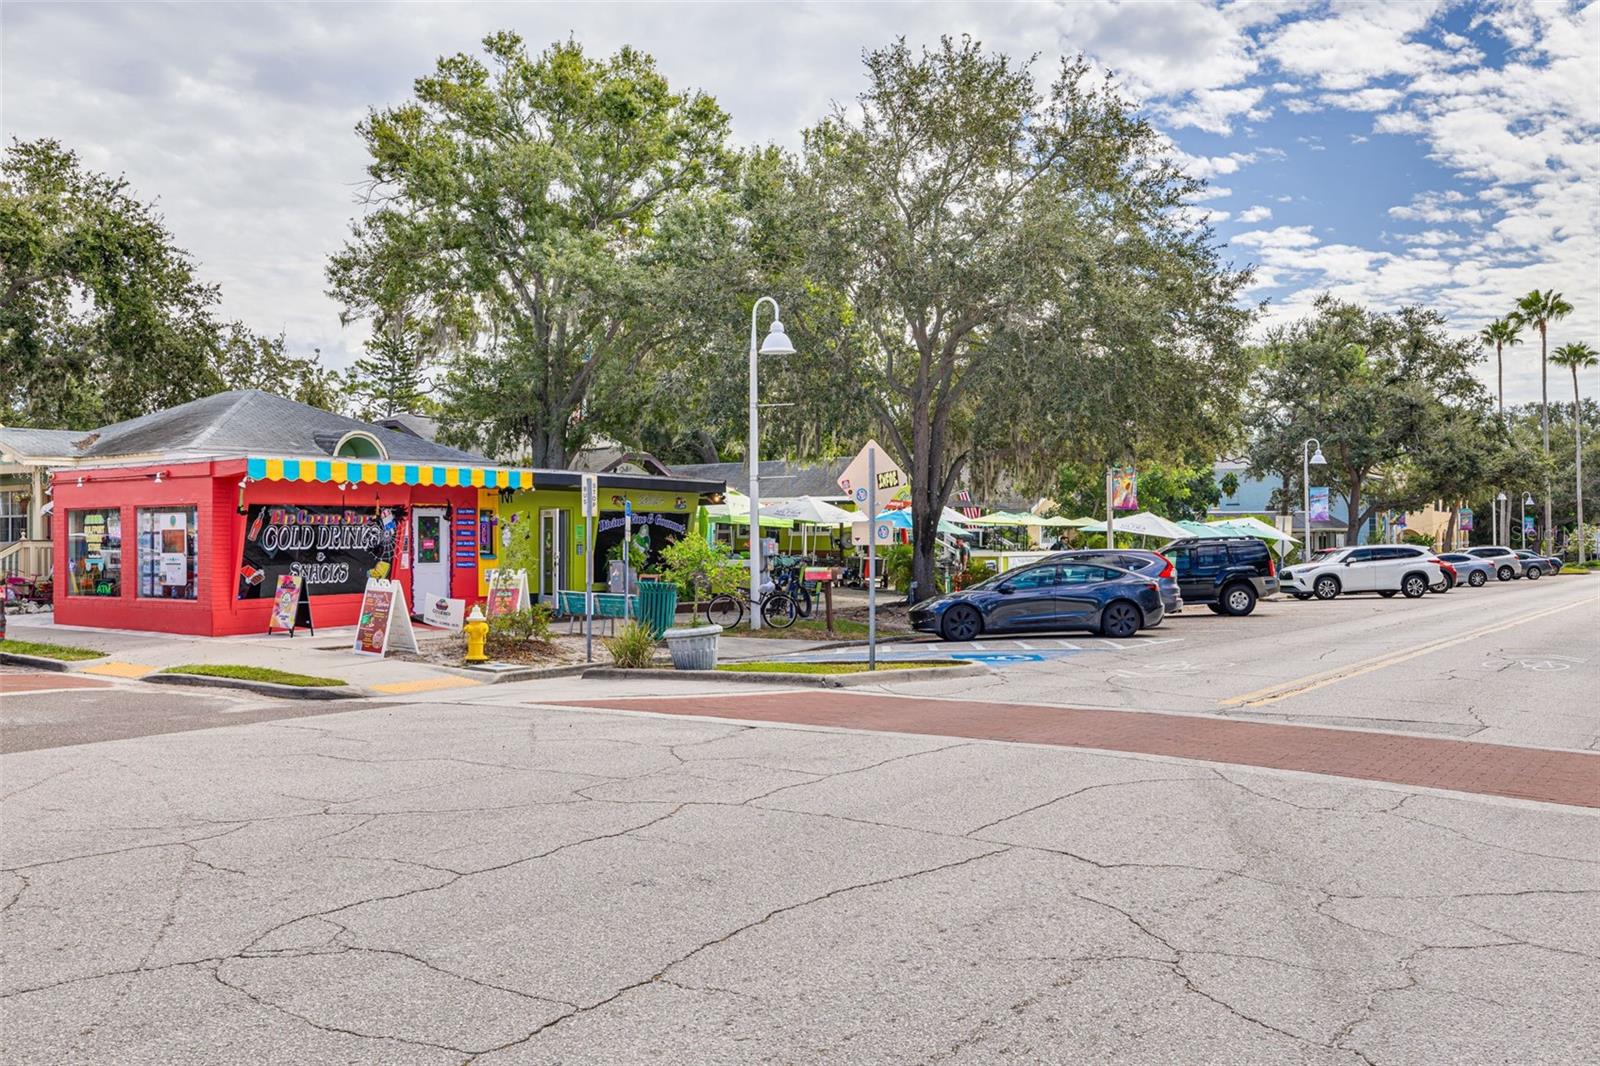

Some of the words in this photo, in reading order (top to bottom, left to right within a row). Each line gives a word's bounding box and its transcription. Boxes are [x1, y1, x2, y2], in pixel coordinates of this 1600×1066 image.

[270, 509, 295, 524] The
[296, 509, 342, 525] Corner
[262, 525, 315, 551] COLD
[316, 525, 382, 551] DRINKS
[316, 552, 326, 561] &
[289, 562, 350, 584] SNACKS
[97, 583, 113, 594] ATM
